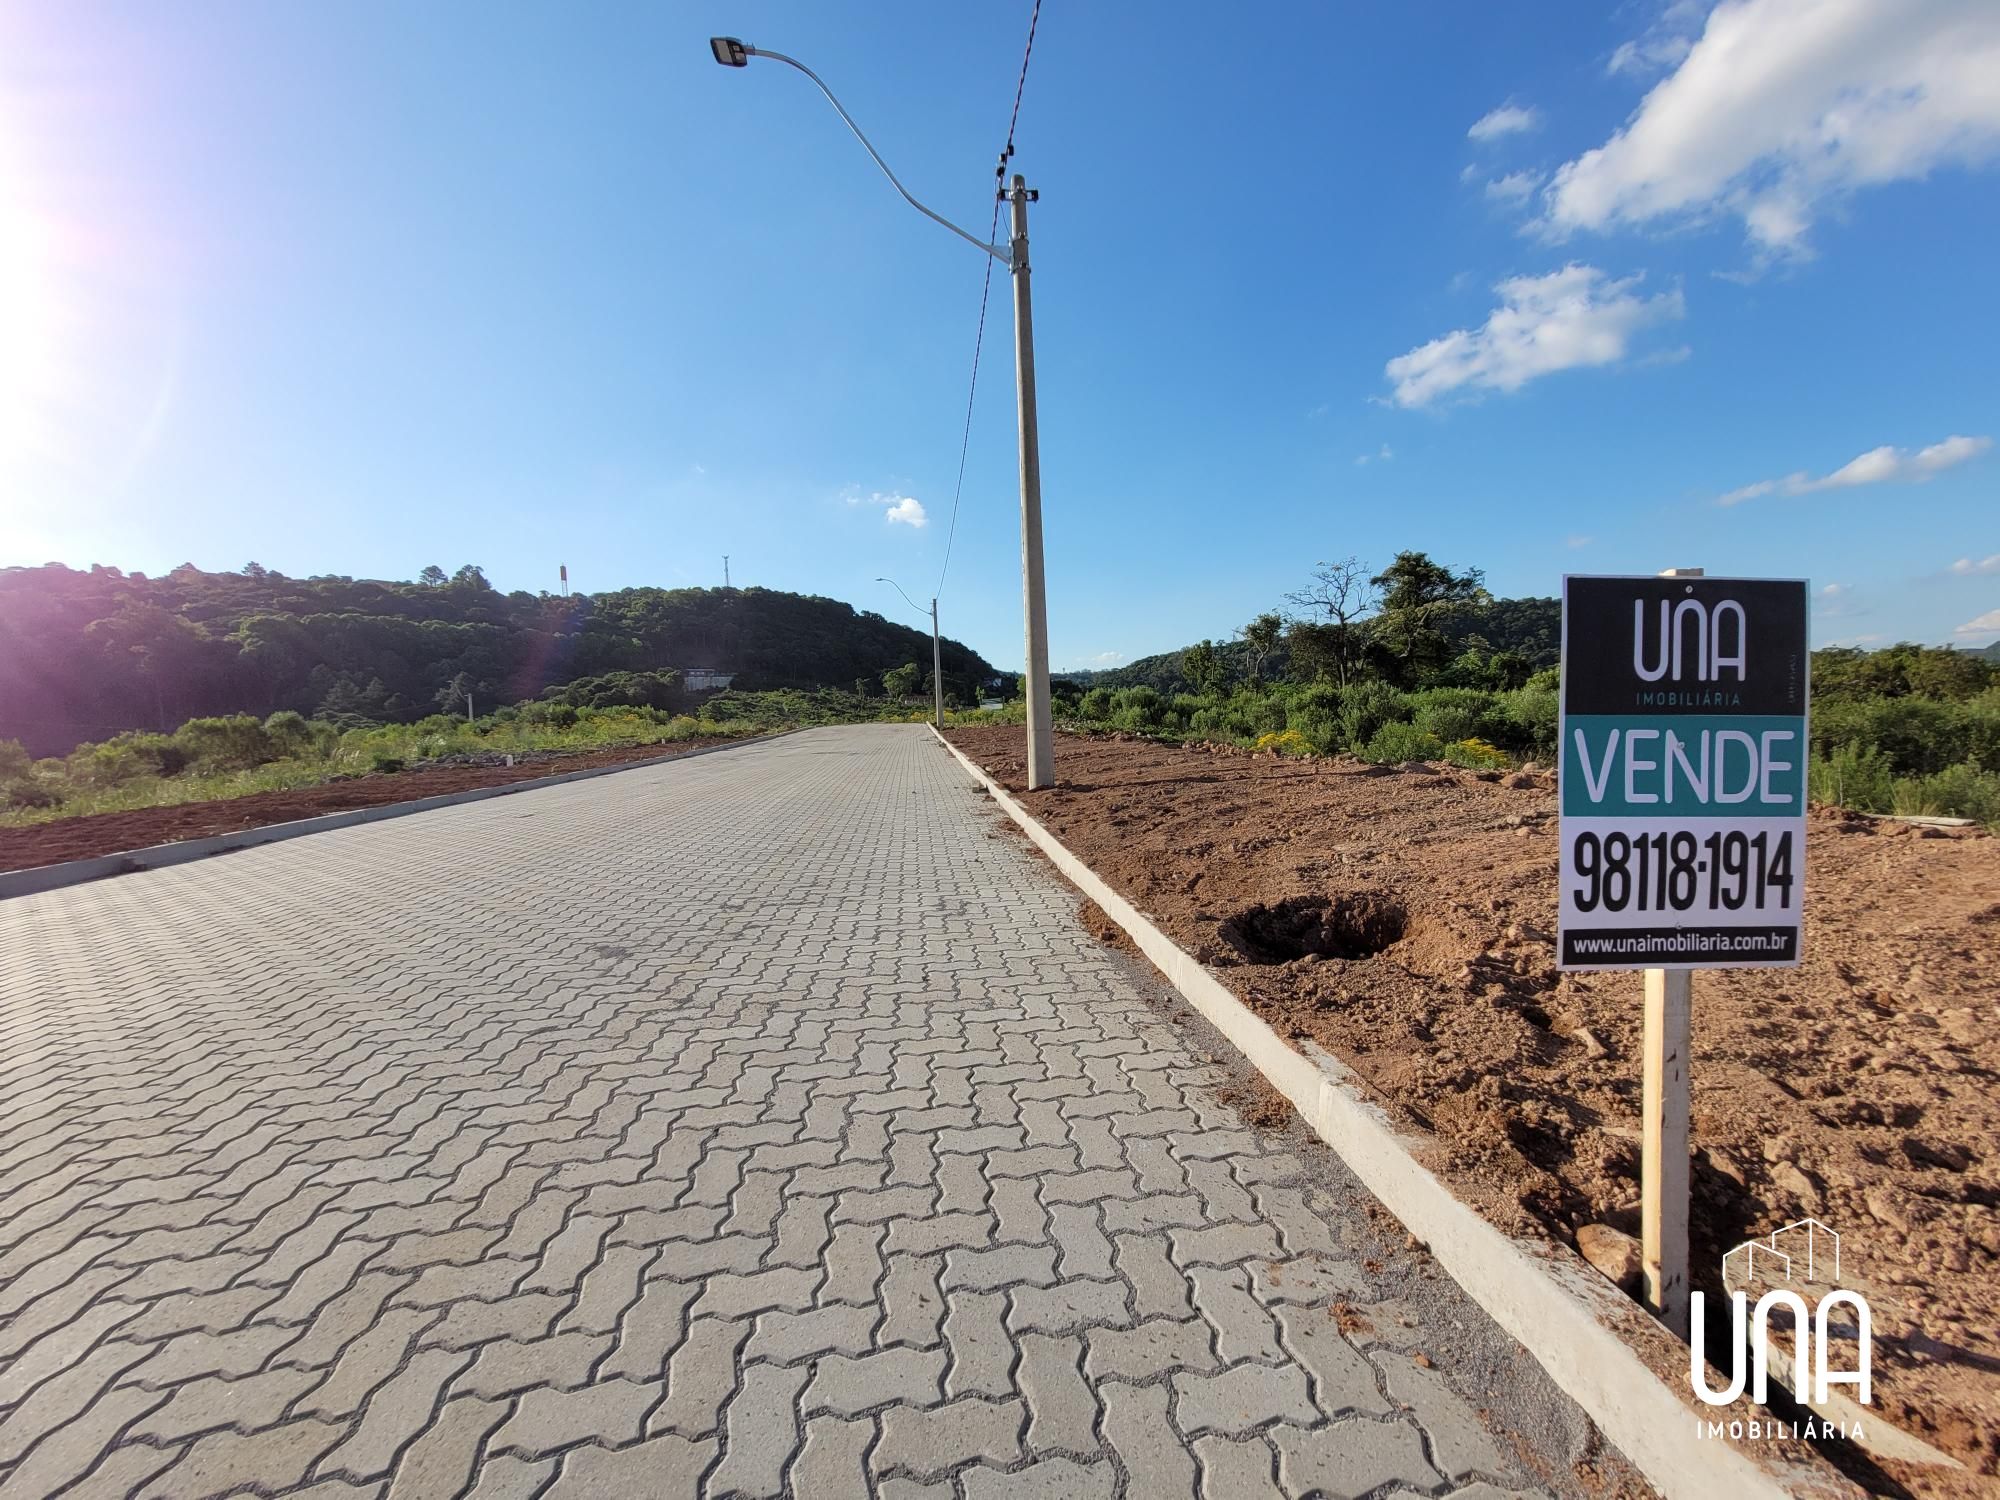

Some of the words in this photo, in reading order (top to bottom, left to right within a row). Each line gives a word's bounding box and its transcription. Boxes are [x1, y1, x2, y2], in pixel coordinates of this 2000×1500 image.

[1634, 599, 1746, 682] UNA
[1636, 689, 1741, 706] IMOBILIÁRIA
[1574, 728, 1795, 804] VENDE
[1573, 831, 1794, 912] 98118-1914
[1574, 932, 1788, 954] www.unaimobiliaria.com.br
